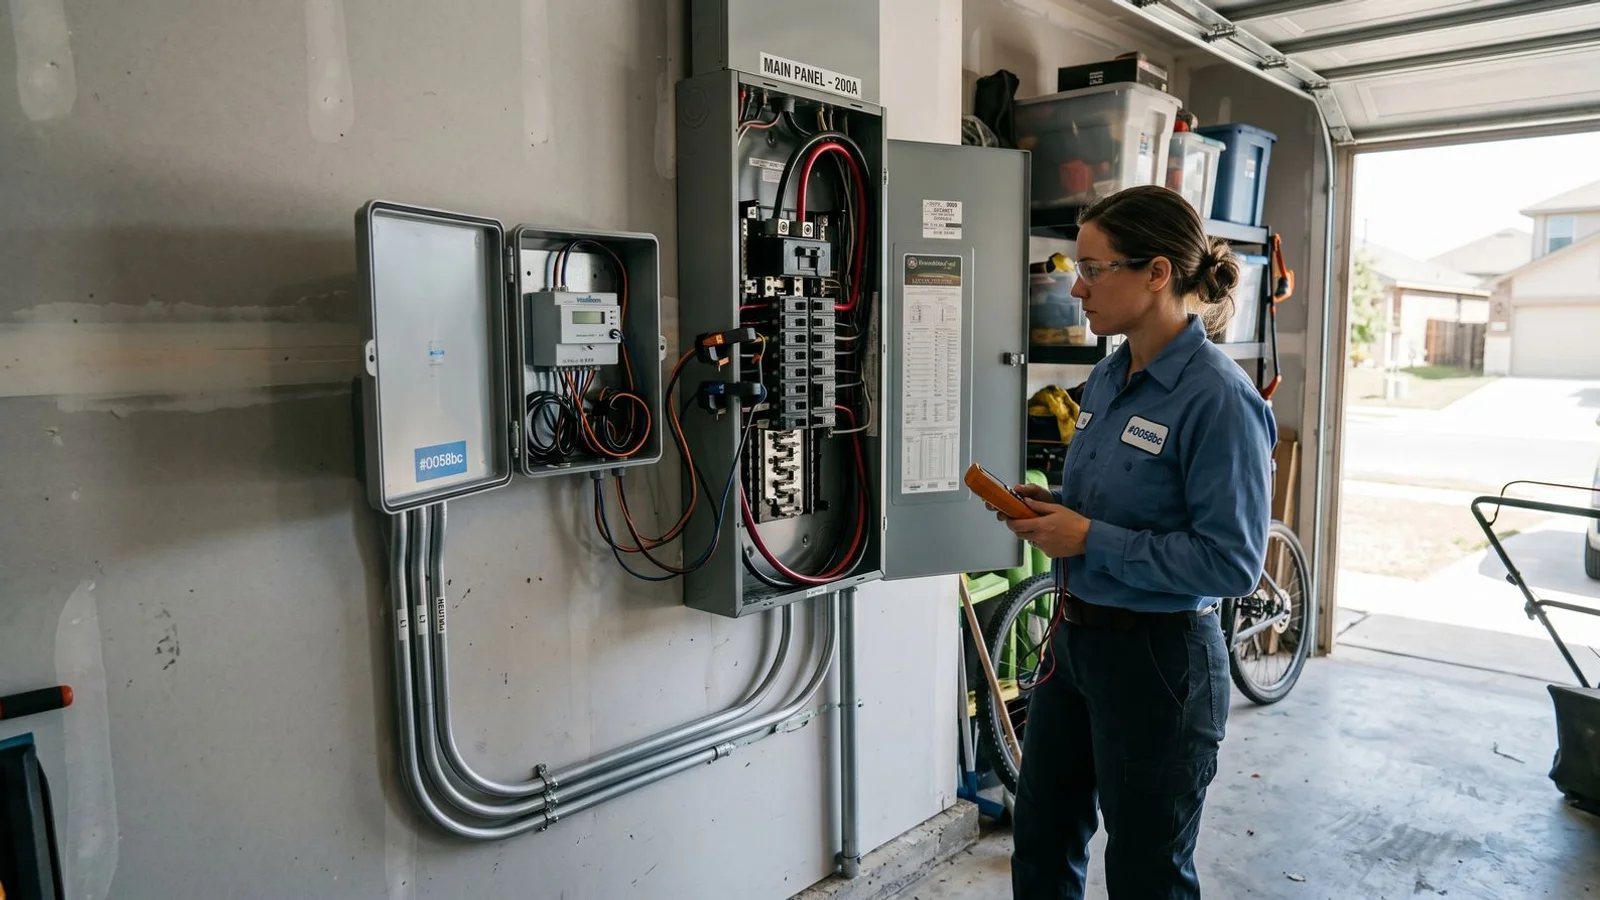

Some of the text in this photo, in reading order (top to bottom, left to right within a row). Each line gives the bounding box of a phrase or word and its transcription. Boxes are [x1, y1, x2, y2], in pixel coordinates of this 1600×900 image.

[763, 57, 791, 78] MAIN
[794, 65, 825, 87] PANEL
[835, 76, 858, 95] 200A
[1127, 425, 1163, 446] #0058bc
[419, 452, 463, 471] #0058bc
